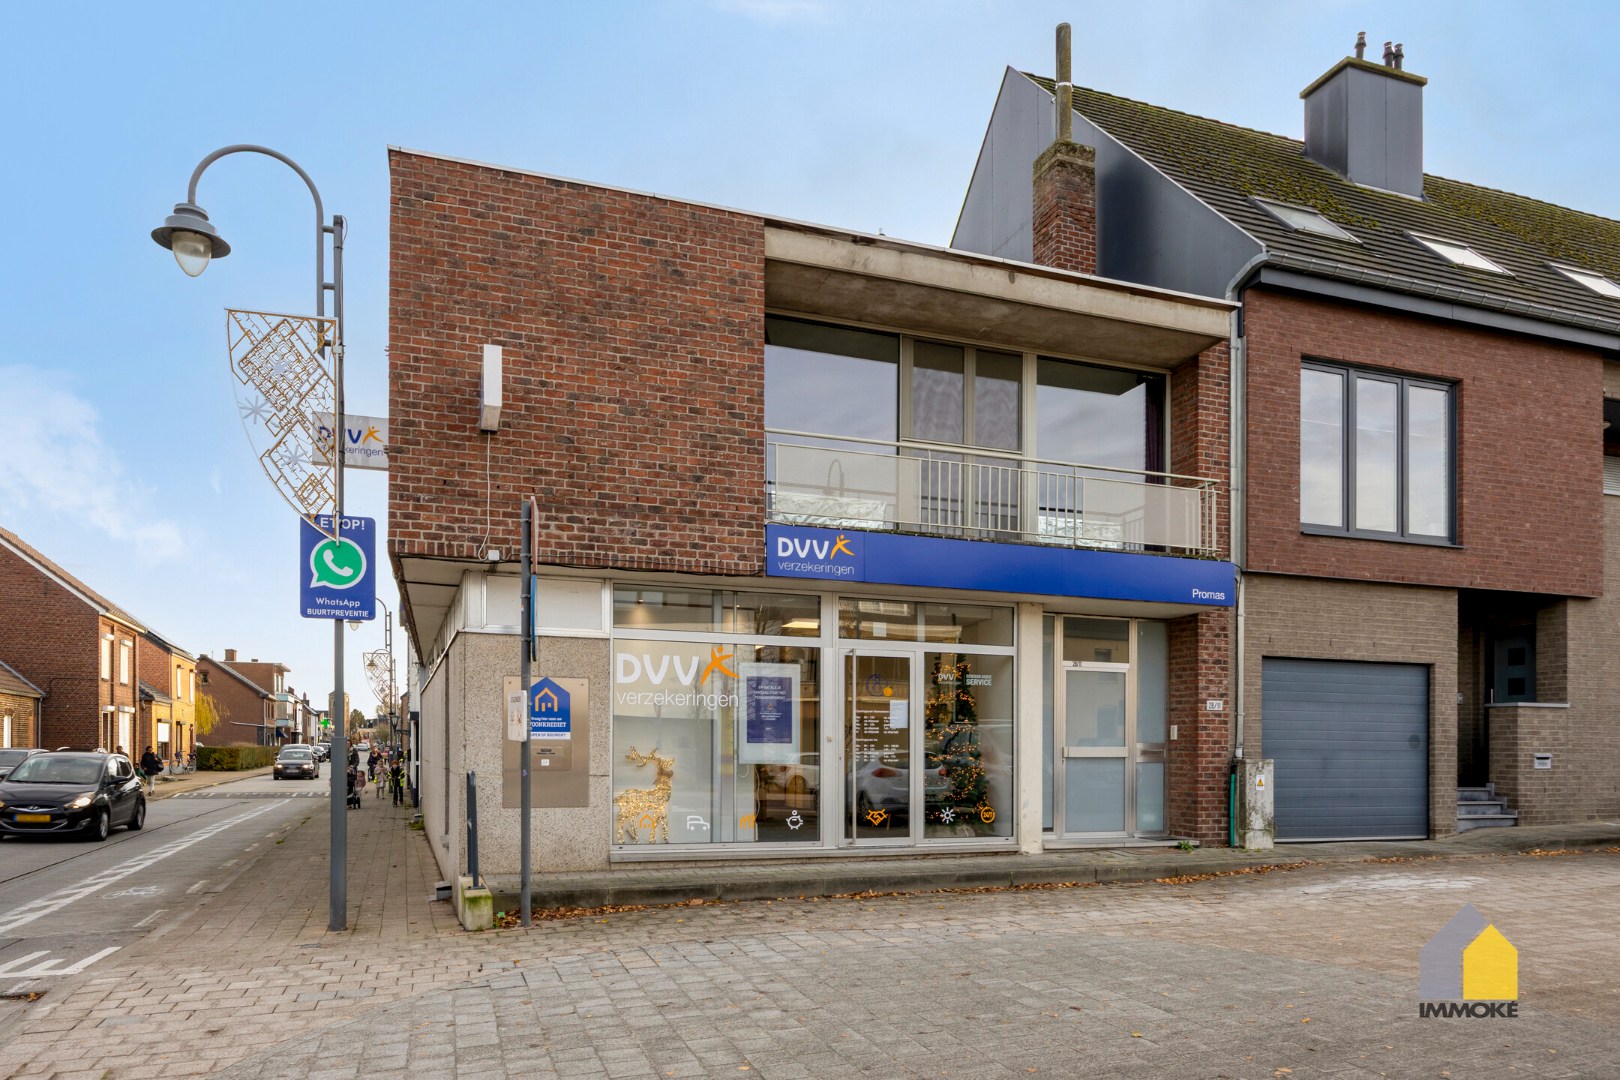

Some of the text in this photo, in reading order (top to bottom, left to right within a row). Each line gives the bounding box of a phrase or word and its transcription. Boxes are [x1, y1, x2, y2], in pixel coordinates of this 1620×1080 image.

[777, 536, 830, 560] DVV
[778, 561, 855, 577] verzekeringen
[1192, 588, 1226, 600] Promas
[315, 597, 361, 608] WhatsApp
[307, 608, 369, 618] BUURTPREVENTIE
[616, 652, 700, 686] DVV
[616, 688, 739, 711] verzekeringen
